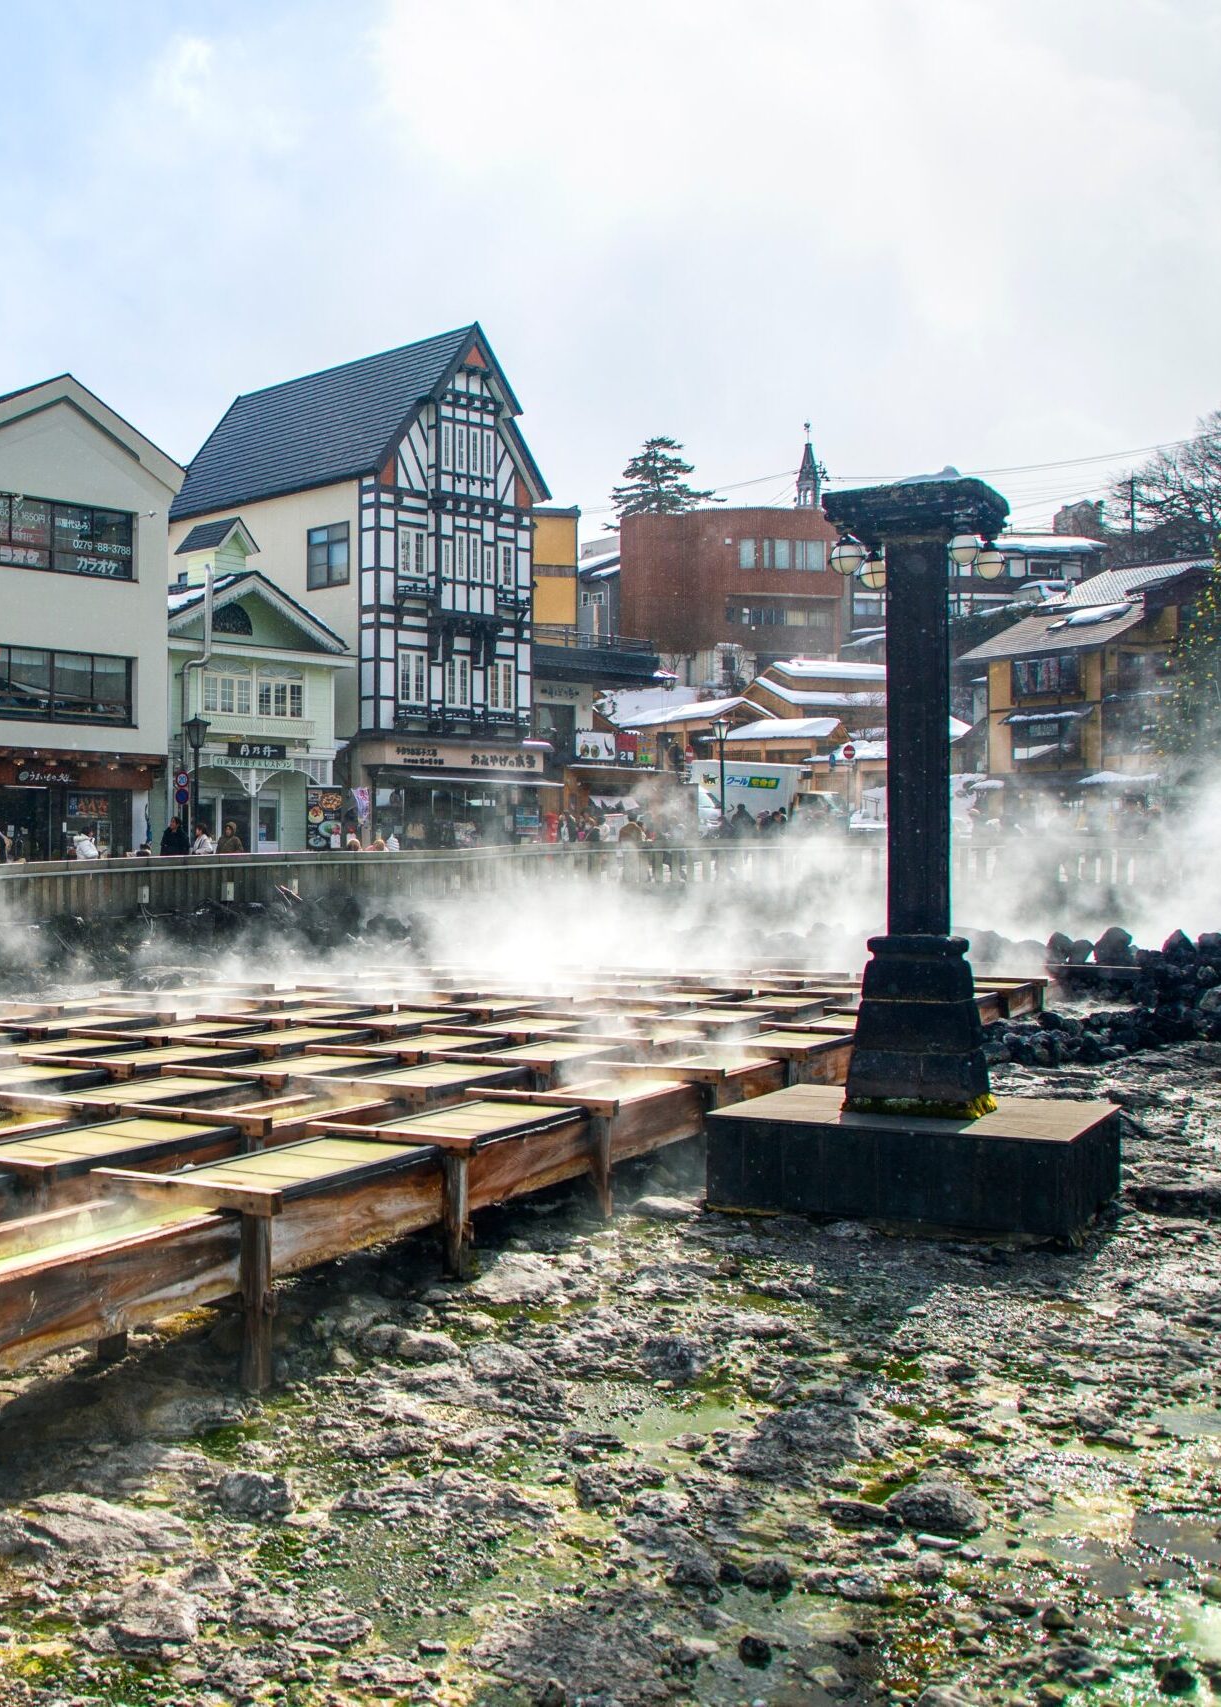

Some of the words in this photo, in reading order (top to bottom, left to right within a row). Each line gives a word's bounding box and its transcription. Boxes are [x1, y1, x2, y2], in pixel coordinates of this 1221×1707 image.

[76, 555, 119, 576] カラオケ
[620, 751, 634, 761] 2階
[726, 776, 749, 786] クール
